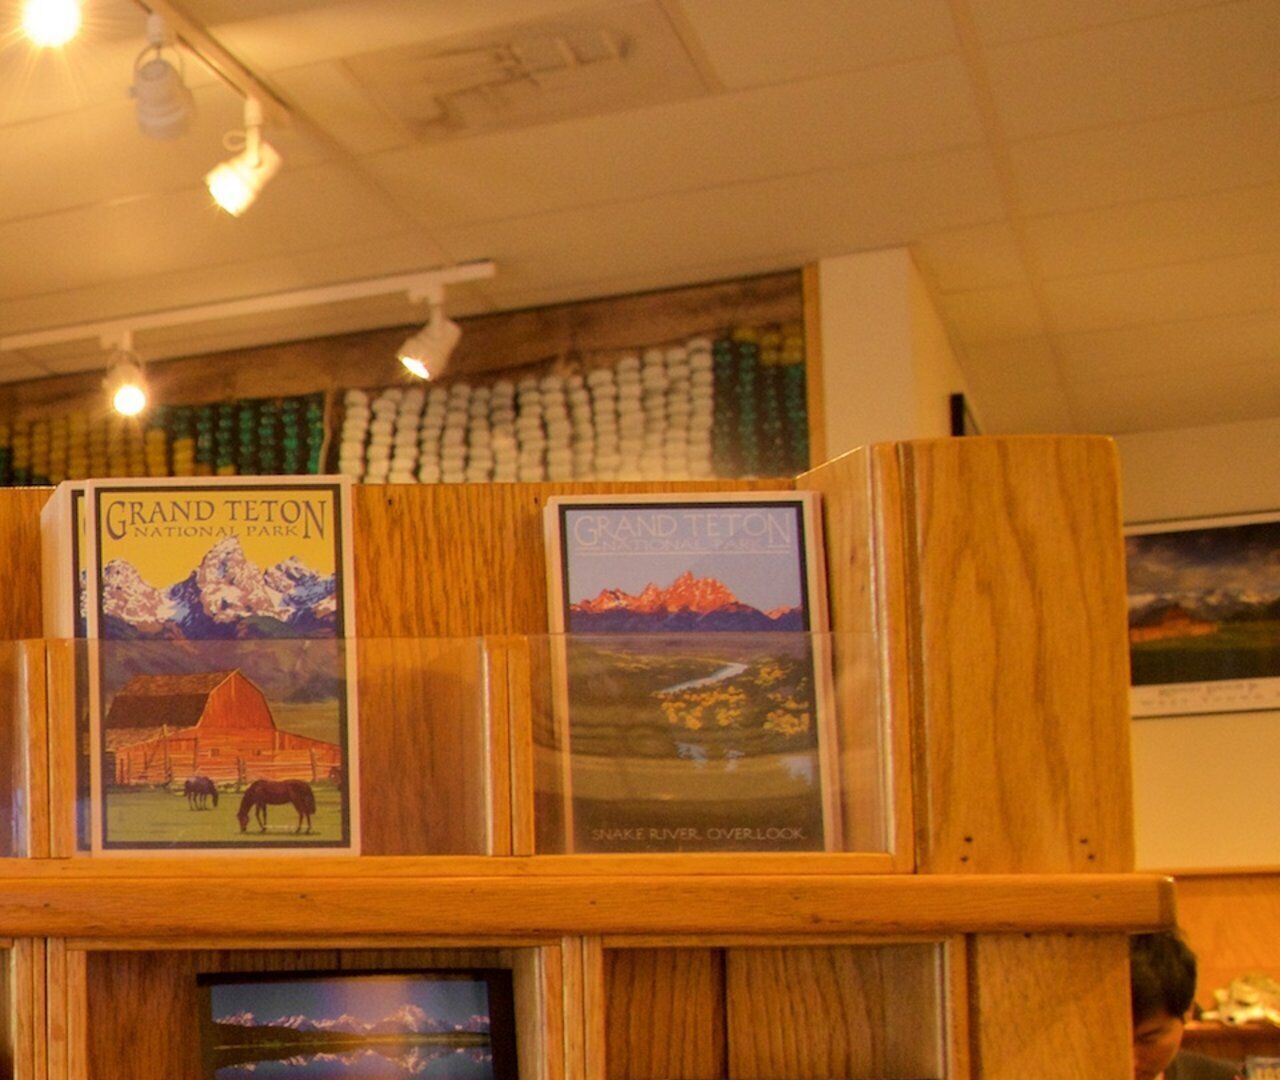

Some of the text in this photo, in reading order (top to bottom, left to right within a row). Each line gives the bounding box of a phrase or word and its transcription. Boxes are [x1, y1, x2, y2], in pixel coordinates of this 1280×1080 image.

[106, 499, 327, 540] GRAND TETON
[134, 525, 300, 538] NATIONAL PARK
[574, 512, 791, 547] GRAND TETON
[591, 827, 807, 841] SNAKE RIVER OVERLOOK
